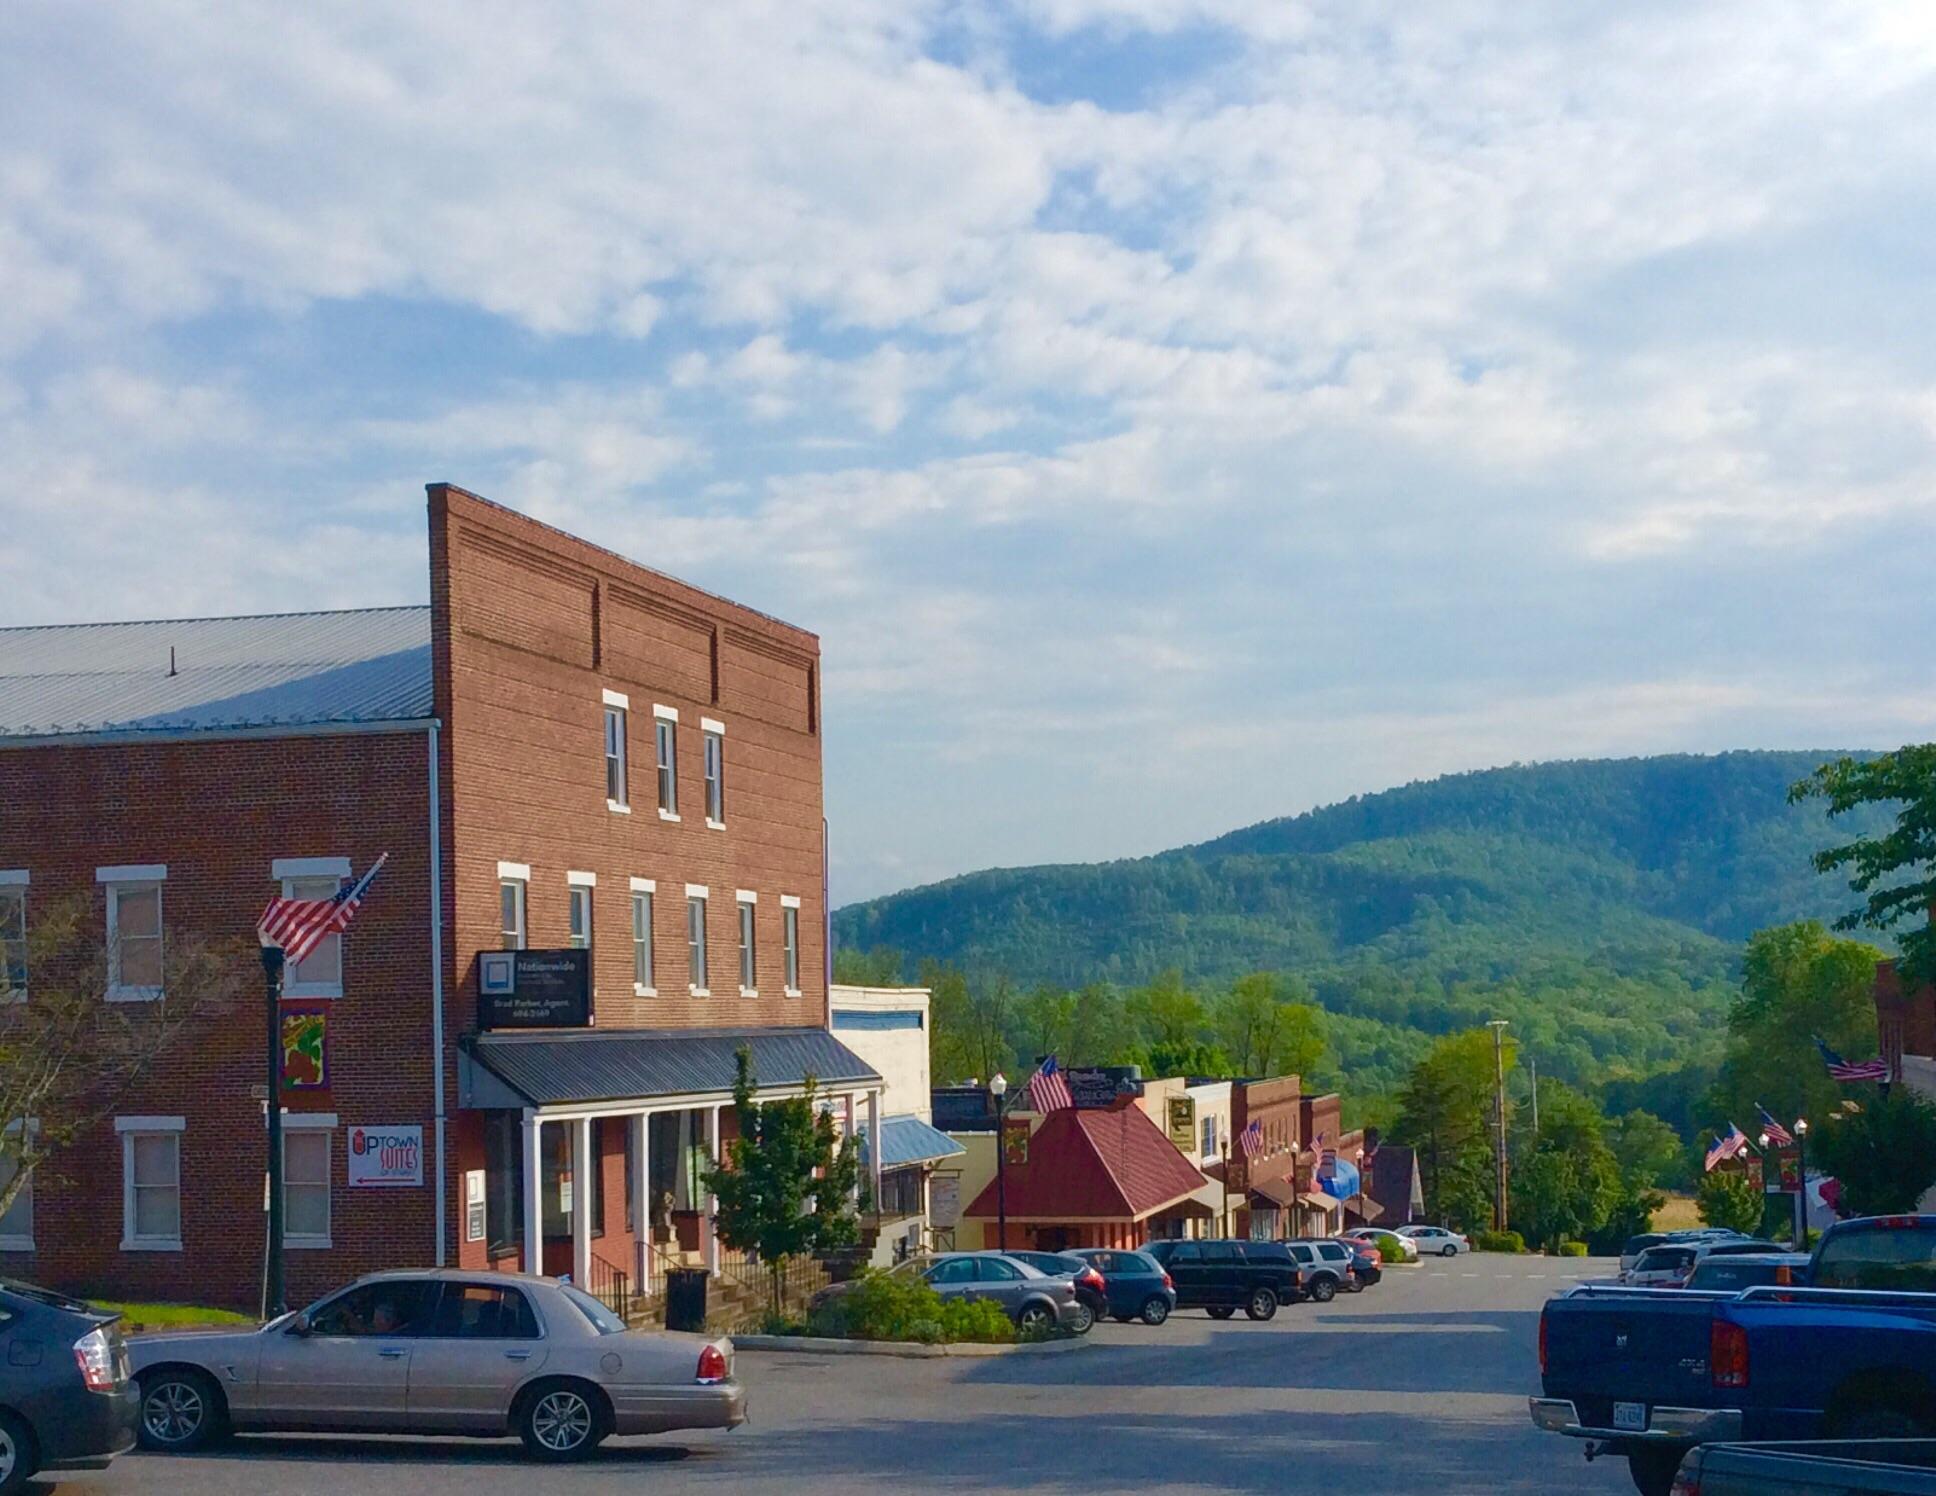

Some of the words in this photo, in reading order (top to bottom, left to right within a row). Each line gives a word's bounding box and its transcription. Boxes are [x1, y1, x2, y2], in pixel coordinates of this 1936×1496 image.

[518, 961, 575, 971] Nationwide
[353, 1135, 419, 1155] UPTOWN
[381, 1148, 418, 1169] SUITES
